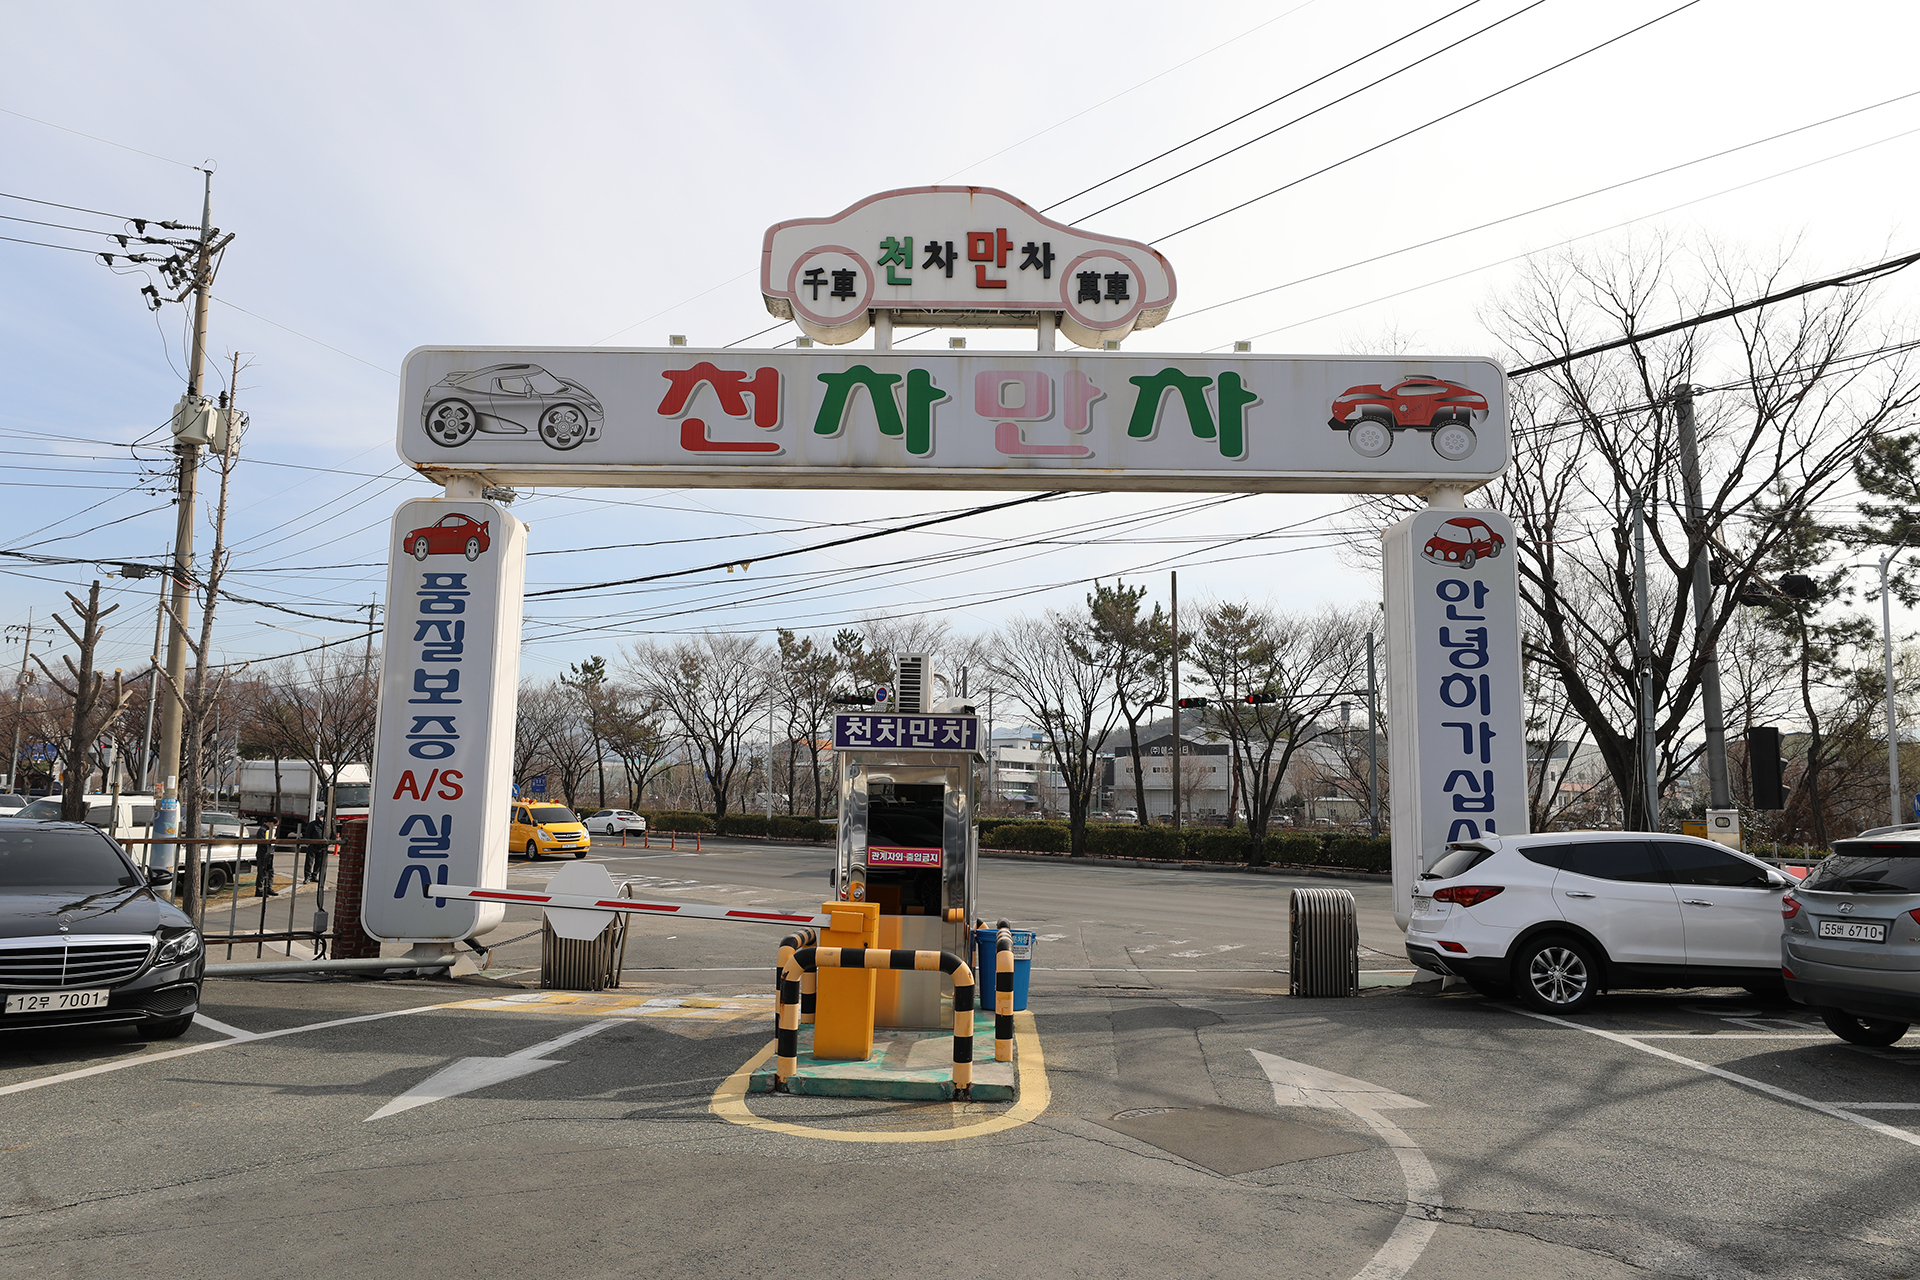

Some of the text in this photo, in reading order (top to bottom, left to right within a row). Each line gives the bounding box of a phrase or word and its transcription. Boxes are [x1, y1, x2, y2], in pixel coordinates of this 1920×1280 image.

[877, 227, 1056, 290] 천차만차
[802, 267, 857, 302] 千車
[1076, 270, 1130, 305] 萬車
[656, 360, 1260, 458] 천차만차
[392, 572, 471, 909] 품질보증 A/S 실시
[844, 717, 971, 749] 천차만차
[871, 851, 938, 862] 관계자외 출입금지
[1824, 923, 1844, 936] 55버
[1848, 925, 1878, 939] 6710
[17, 992, 100, 1011] 12무 7001
